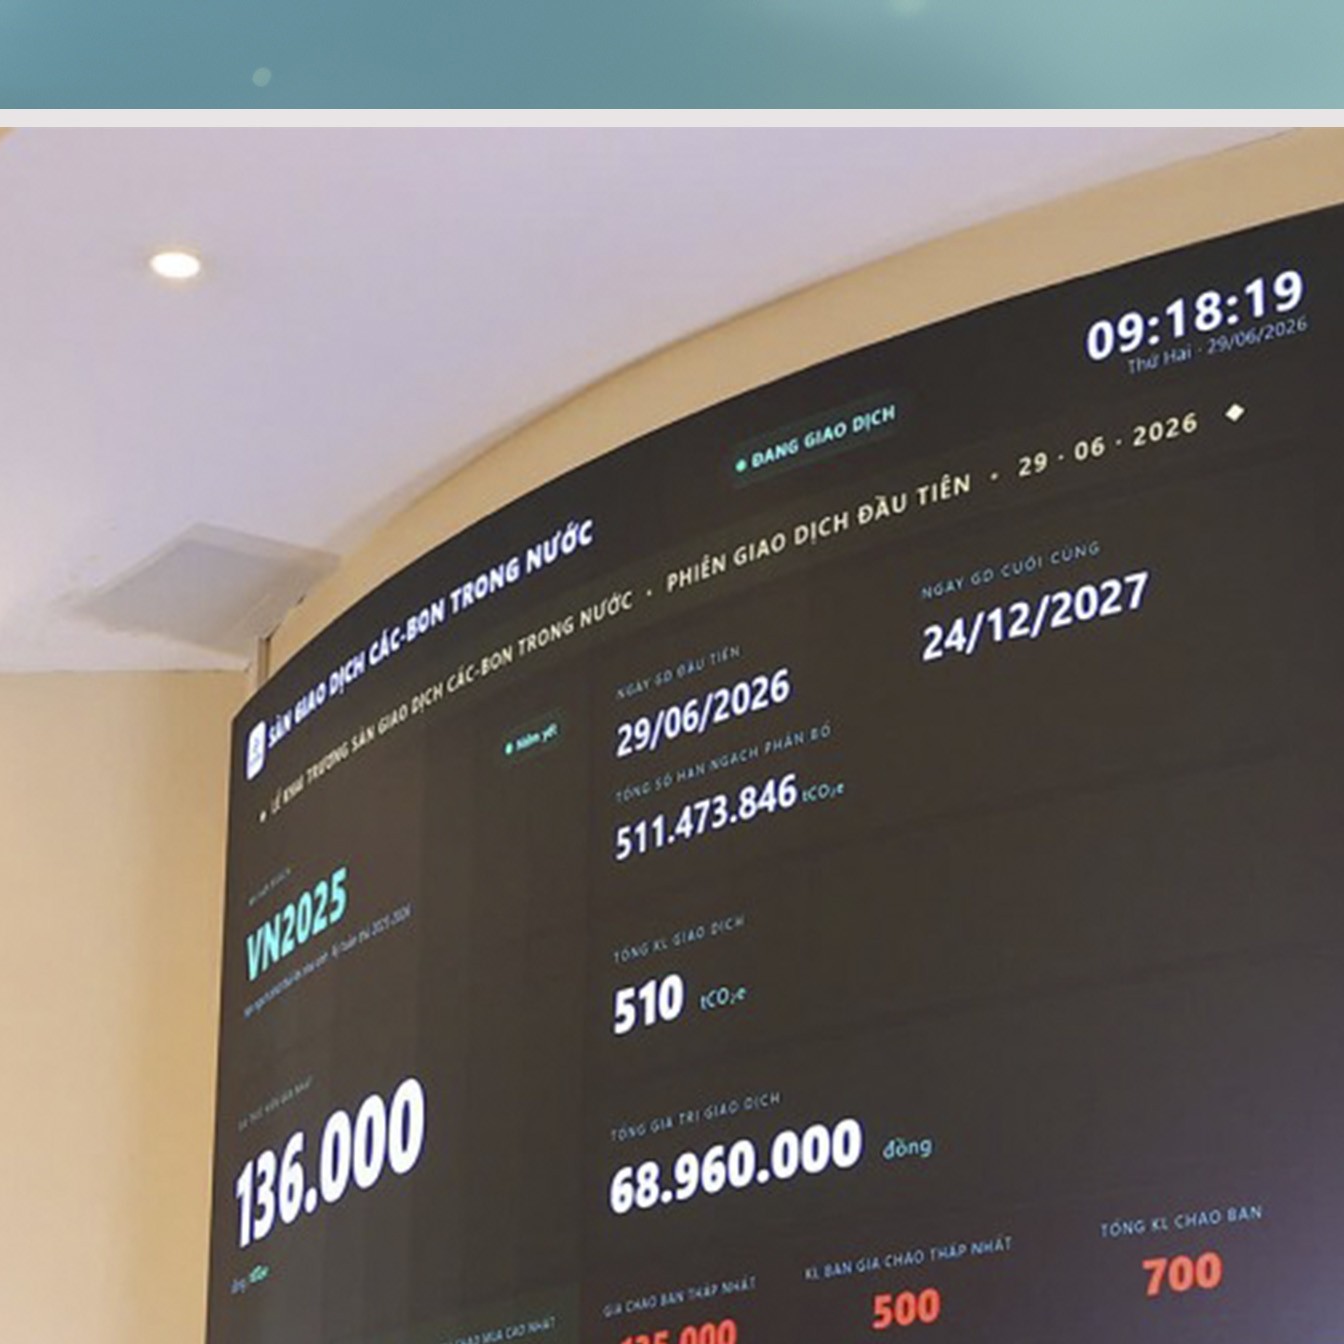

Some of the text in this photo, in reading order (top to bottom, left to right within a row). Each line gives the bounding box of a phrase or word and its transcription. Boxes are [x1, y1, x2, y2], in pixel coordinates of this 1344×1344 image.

[1086, 270, 1304, 361] 09:18:19
[1163, 346, 1192, 365] Hai
[1207, 315, 1308, 355] 29/06/2026
[751, 404, 896, 468] ĐANG GIAO DỊCH
[446, 645, 513, 693] CÁC-BON
[518, 616, 574, 656] TRONG
[580, 590, 633, 628] NƯỚC
[666, 554, 726, 592] PHIÊN
[733, 532, 786, 567] GIAO
[794, 511, 849, 545] DỊCH
[857, 493, 907, 525] ĐẦU
[917, 473, 971, 507] TIÊN
[1018, 451, 1047, 477] 29
[1074, 436, 1106, 461] 06
[1133, 412, 1198, 448] 2026
[295, 683, 326, 723] GIAO
[329, 651, 366, 694] DỊCH
[369, 598, 445, 666] CÁC-BON
[450, 557, 520, 614] TRONG
[526, 519, 593, 573] NƯỚC
[922, 572, 1149, 661] 24/12/2027
[616, 668, 792, 758] 29/06/2026
[615, 773, 798, 862] 511.473.846
[246, 866, 347, 982] VN2025
[614, 973, 684, 1035] 510
[236, 1077, 426, 1248] 136.000
[610, 1118, 862, 1215] 68.960.000
[872, 1287, 940, 1330] 500
[1142, 1251, 1223, 1297] 700
